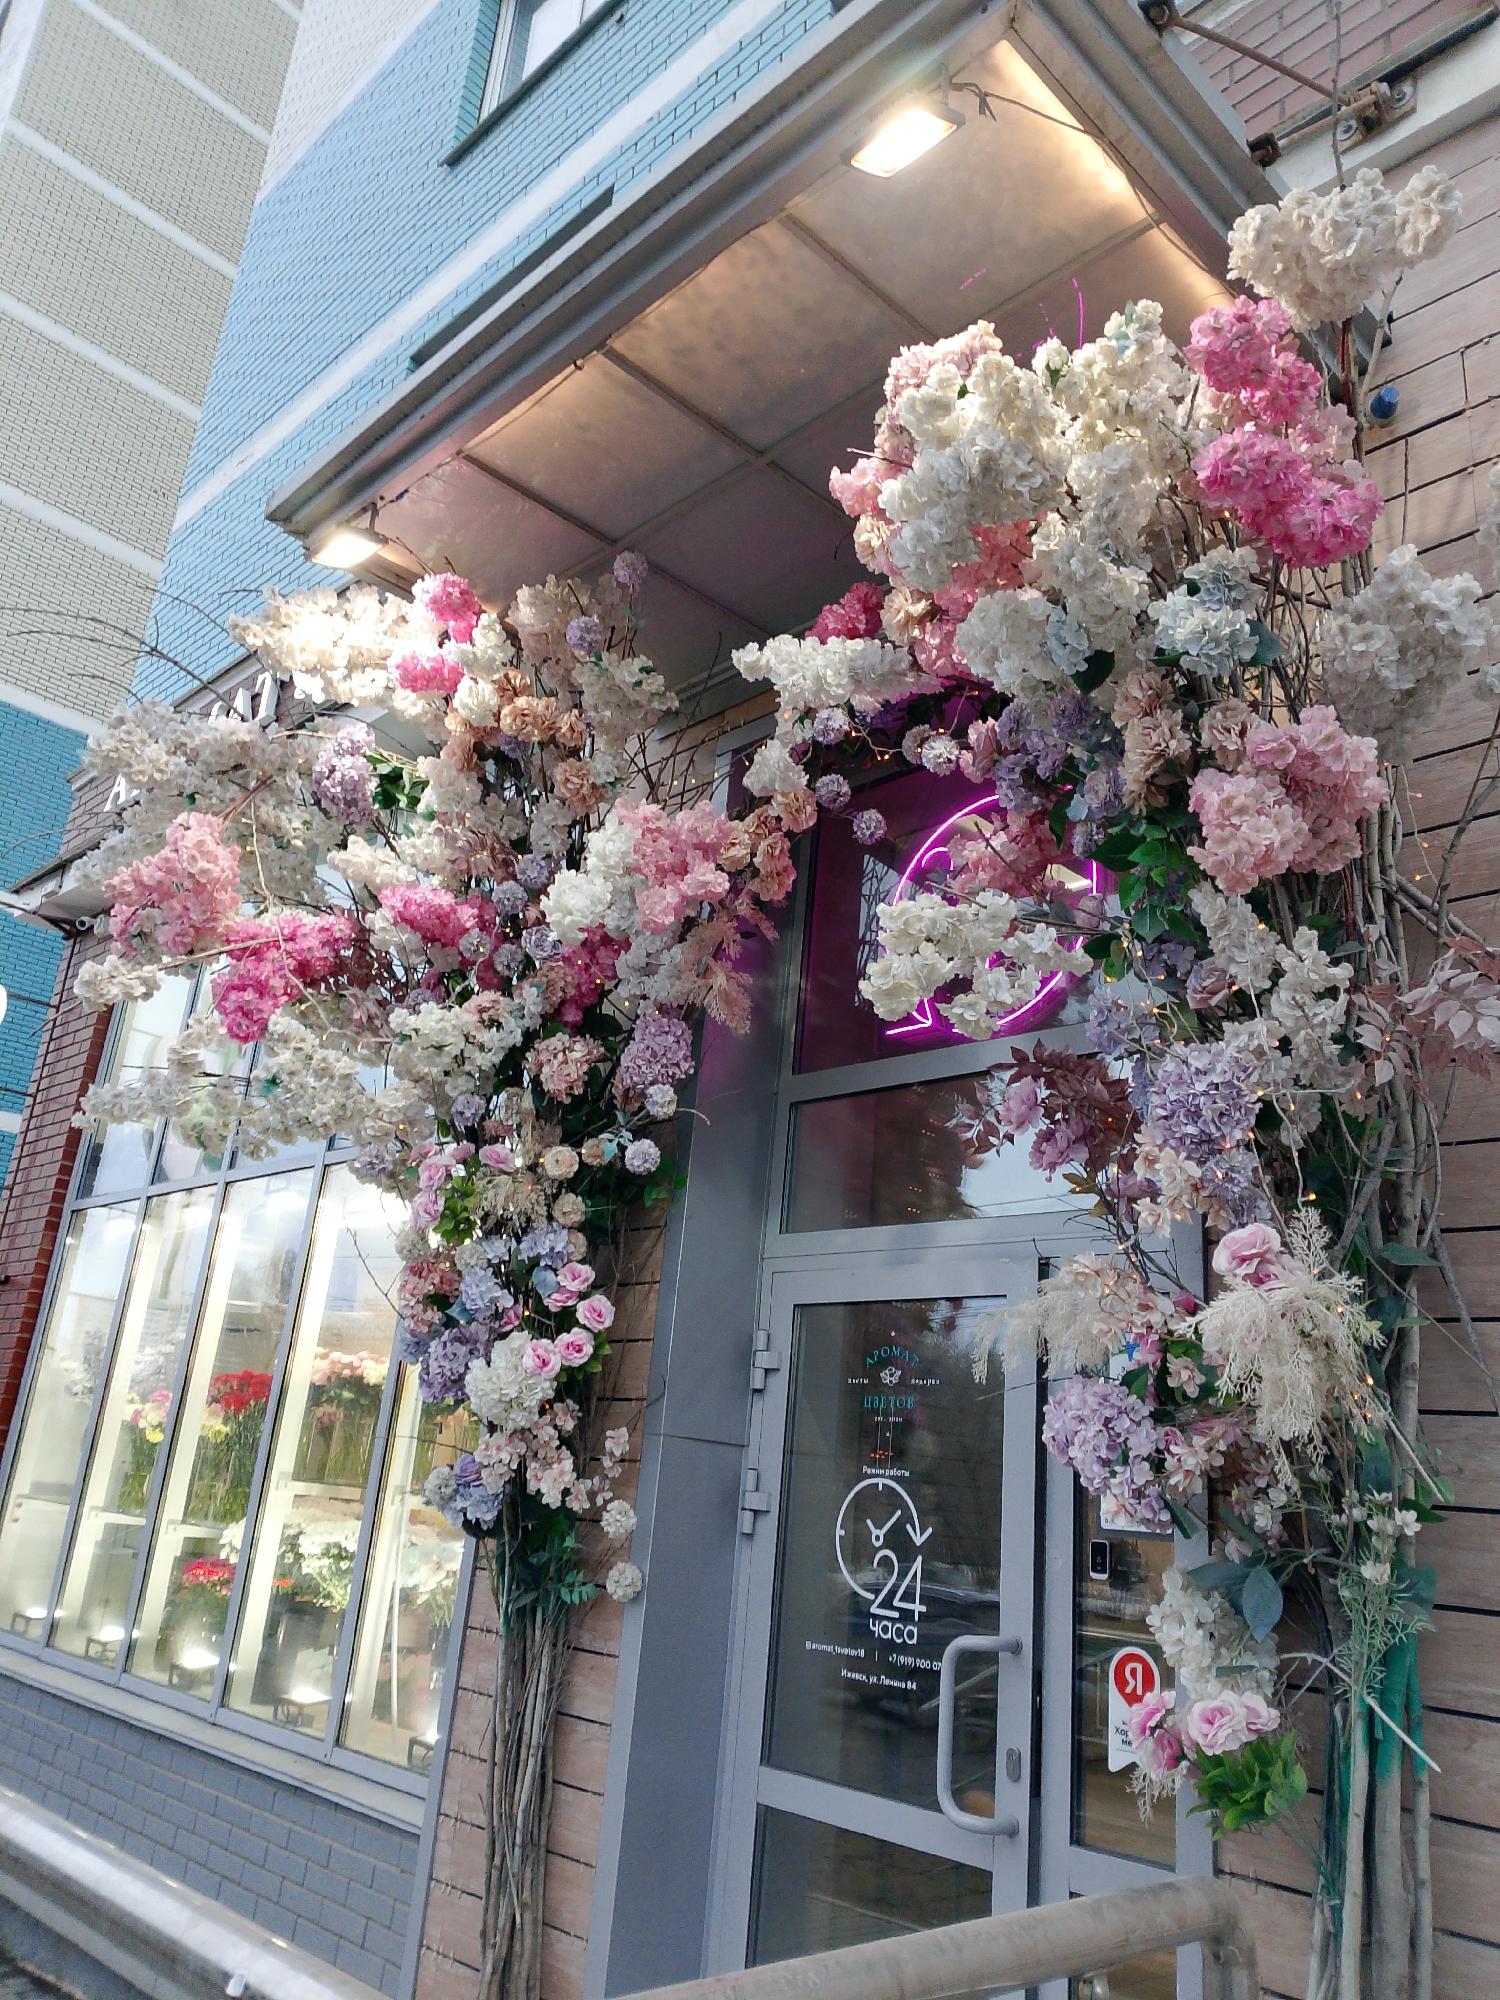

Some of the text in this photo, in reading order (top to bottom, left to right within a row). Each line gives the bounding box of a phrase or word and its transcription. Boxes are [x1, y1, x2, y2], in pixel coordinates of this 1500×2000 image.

[865, 1345, 919, 1369] АРОМАТ
[863, 1395, 914, 1411] ЦВЕТОВ
[862, 1465, 910, 1478] Режим работы
[870, 1549, 927, 1622] 24
[869, 1618, 918, 1645] часа
[915, 1658, 931, 1670] 900
